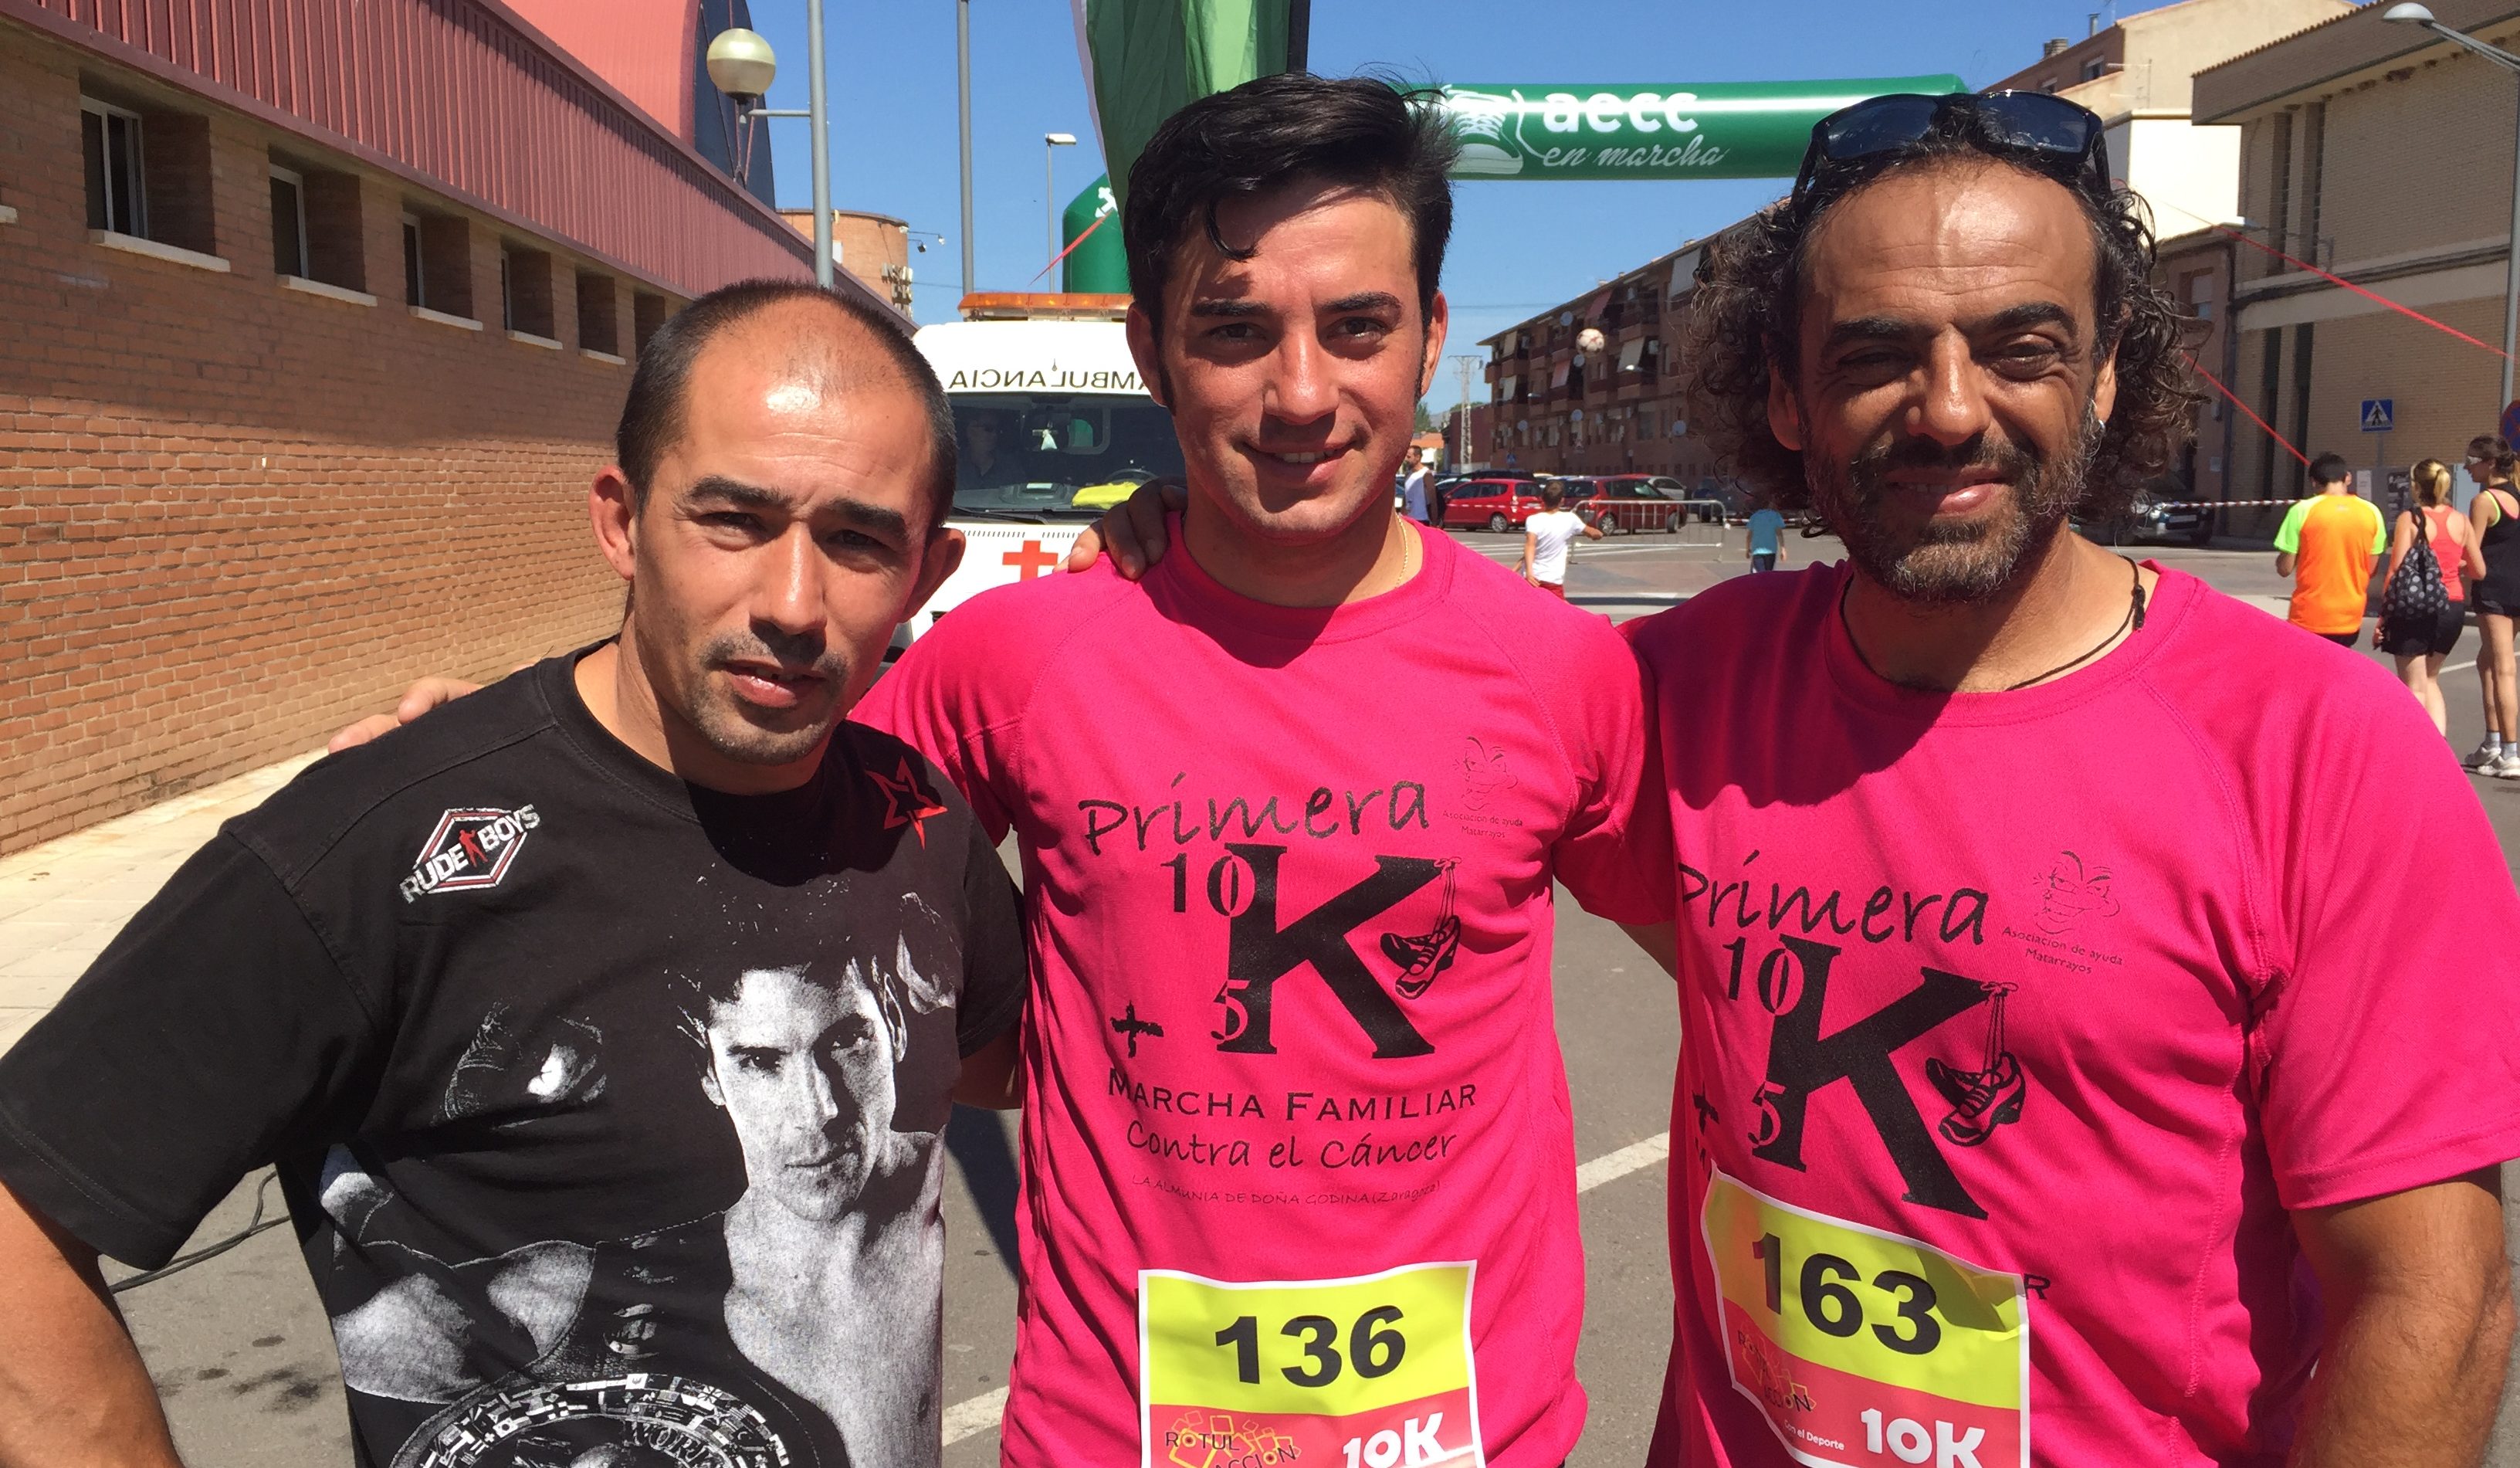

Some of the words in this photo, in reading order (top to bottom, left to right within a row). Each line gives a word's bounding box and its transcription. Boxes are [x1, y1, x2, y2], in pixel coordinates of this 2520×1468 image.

[1543, 92, 1699, 133] aecc
[1544, 145, 1592, 167] en
[1594, 134, 1729, 167] marcha
[399, 842, 469, 904] RUDE
[476, 804, 540, 852] BOYS
[2002, 926, 2067, 951] Asociacion
[2071, 944, 2085, 956] de
[2089, 950, 2123, 965] ayuda
[1108, 1066, 1265, 1118] MARCHA
[1285, 1083, 1477, 1121] FAMILIAR
[1126, 1119, 1250, 1167] Contra
[1268, 1135, 1303, 1168] el
[1155, 1179, 1219, 1202] ALMUNIA
[1226, 1192, 1245, 1203] DE
[1252, 1191, 1300, 1205] DOÑA
[1753, 1232, 1942, 1356] 163
[1214, 1304, 1406, 1388] 136
[1165, 1431, 1241, 1452] ROTUL
[1342, 1412, 1446, 1468] 10K
[1797, 1429, 1805, 1439] el
[1806, 1431, 1846, 1451] Deporte
[1861, 1408, 1985, 1468] 10K
